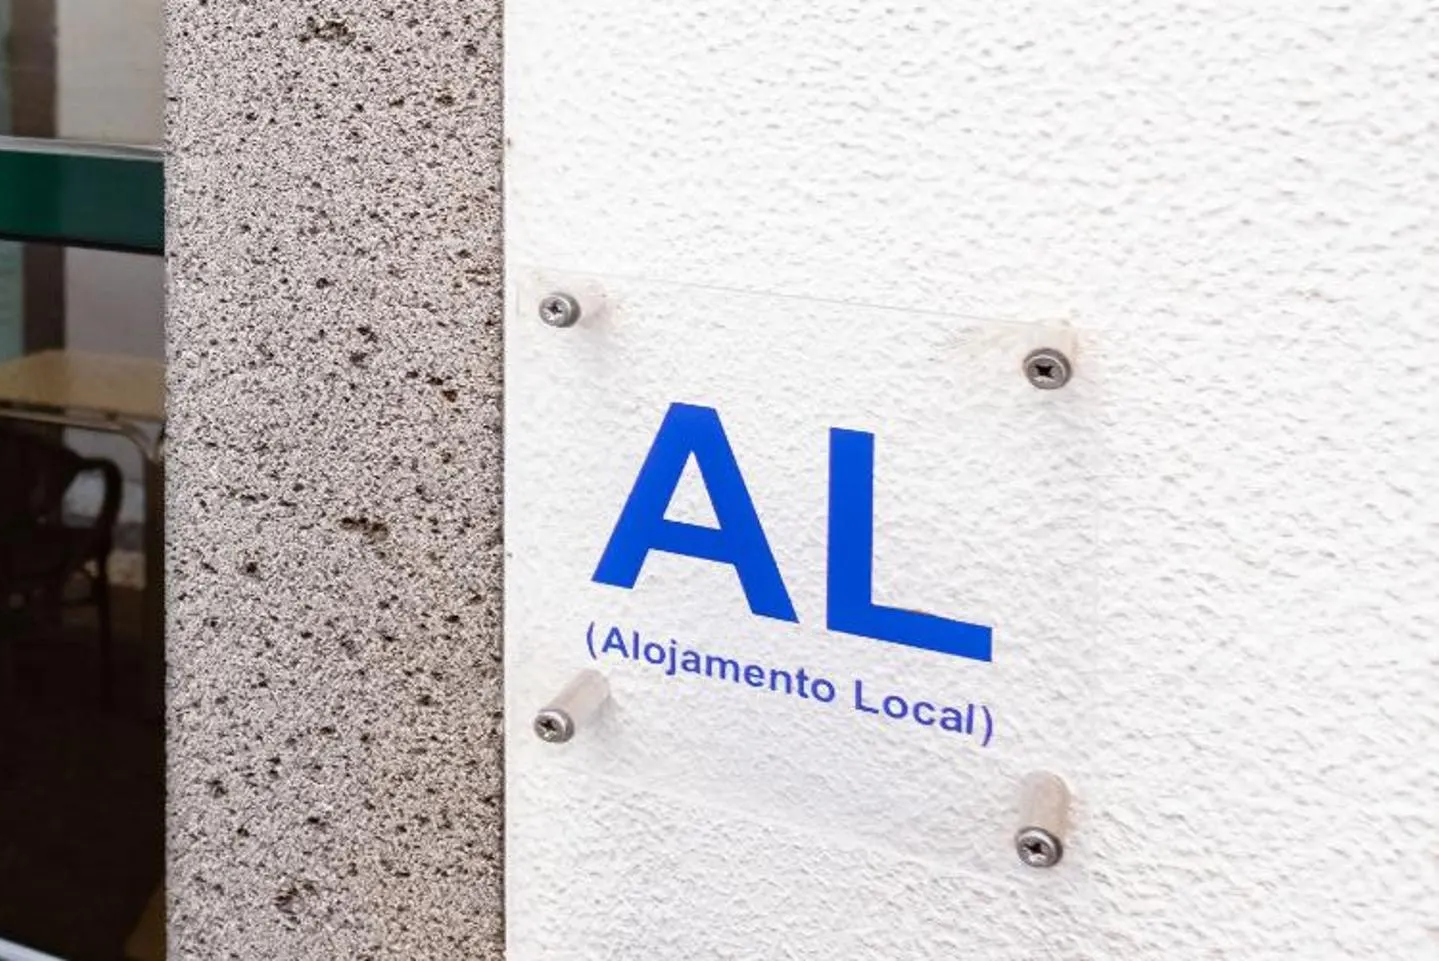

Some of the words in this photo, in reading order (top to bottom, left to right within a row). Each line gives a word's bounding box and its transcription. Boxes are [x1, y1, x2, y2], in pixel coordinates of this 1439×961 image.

[591, 402, 993, 663] AL
[585, 620, 837, 704] (Alojamento
[853, 678, 995, 746] Local)
